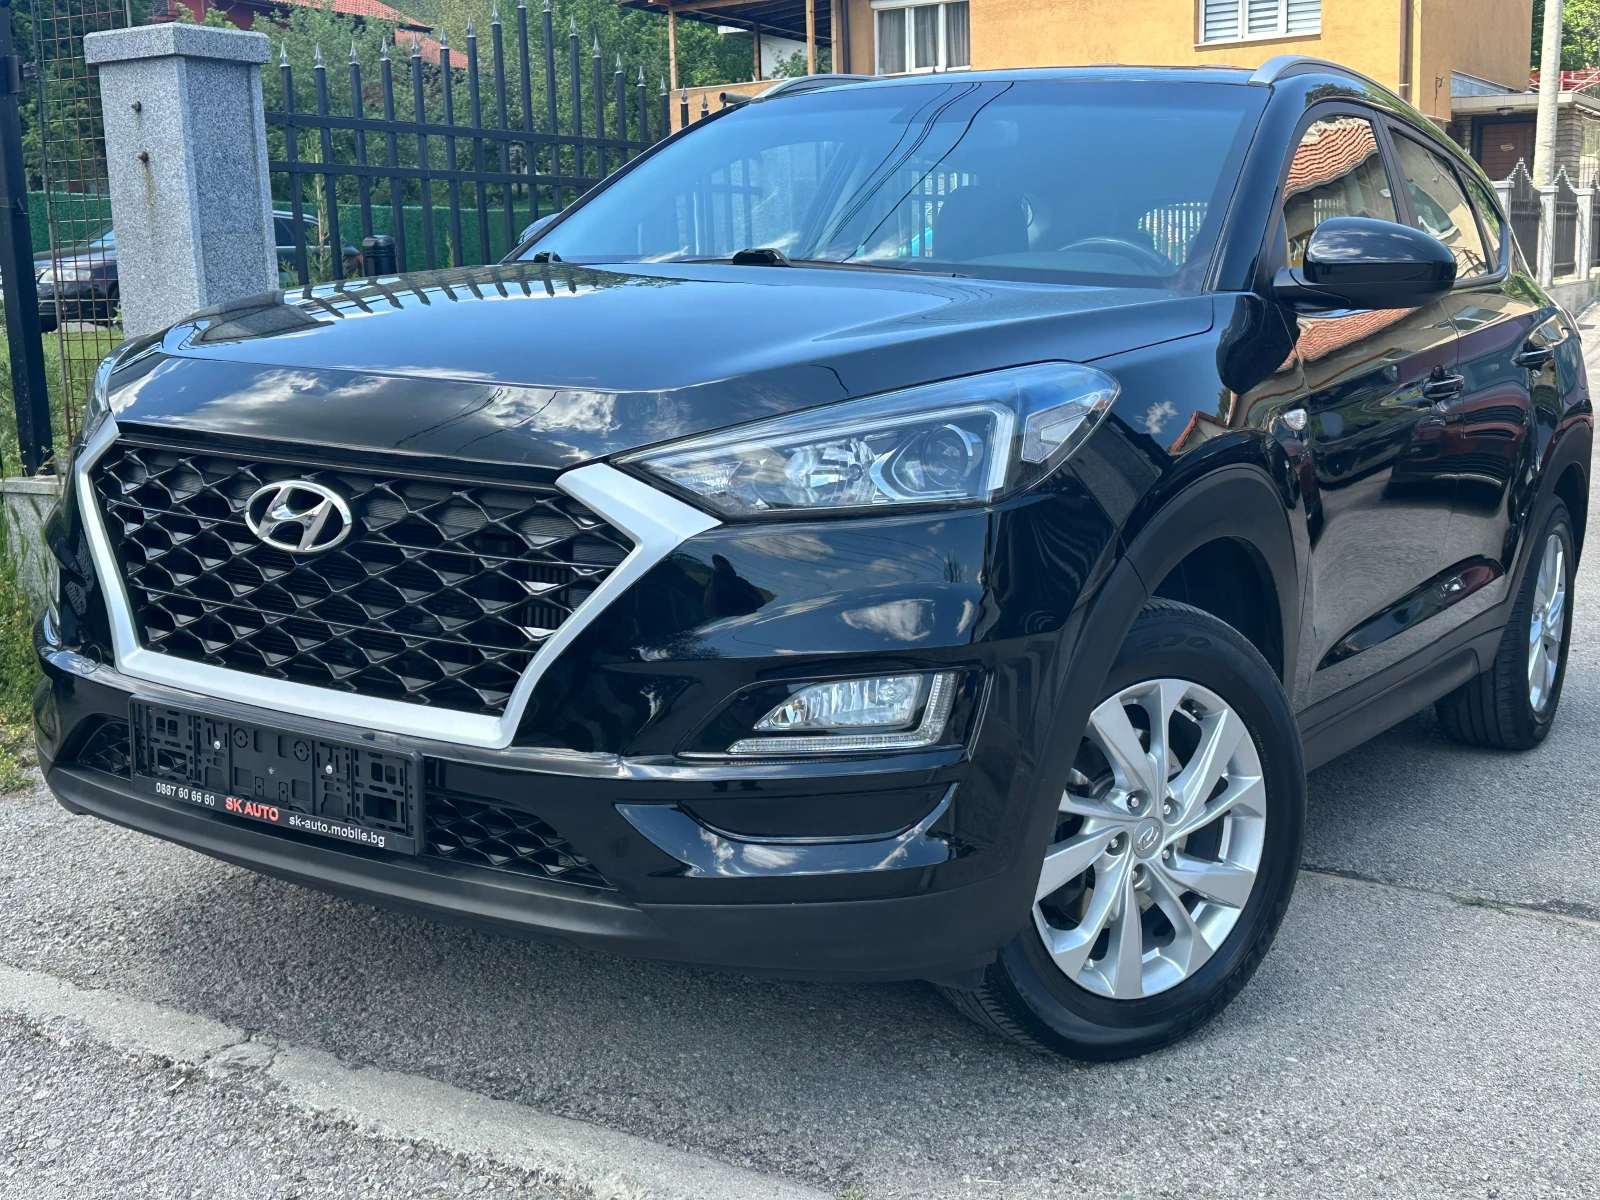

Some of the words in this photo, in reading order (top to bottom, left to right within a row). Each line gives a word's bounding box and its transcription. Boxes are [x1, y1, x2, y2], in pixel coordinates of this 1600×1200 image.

[156, 782, 176, 797] 0887
[178, 787, 189, 800] 60
[191, 791, 202, 803] 66
[204, 794, 215, 806] 60
[225, 797, 242, 813] SK
[244, 802, 279, 821] AUTO
[289, 815, 385, 847] sk-auto.mobile.bg
